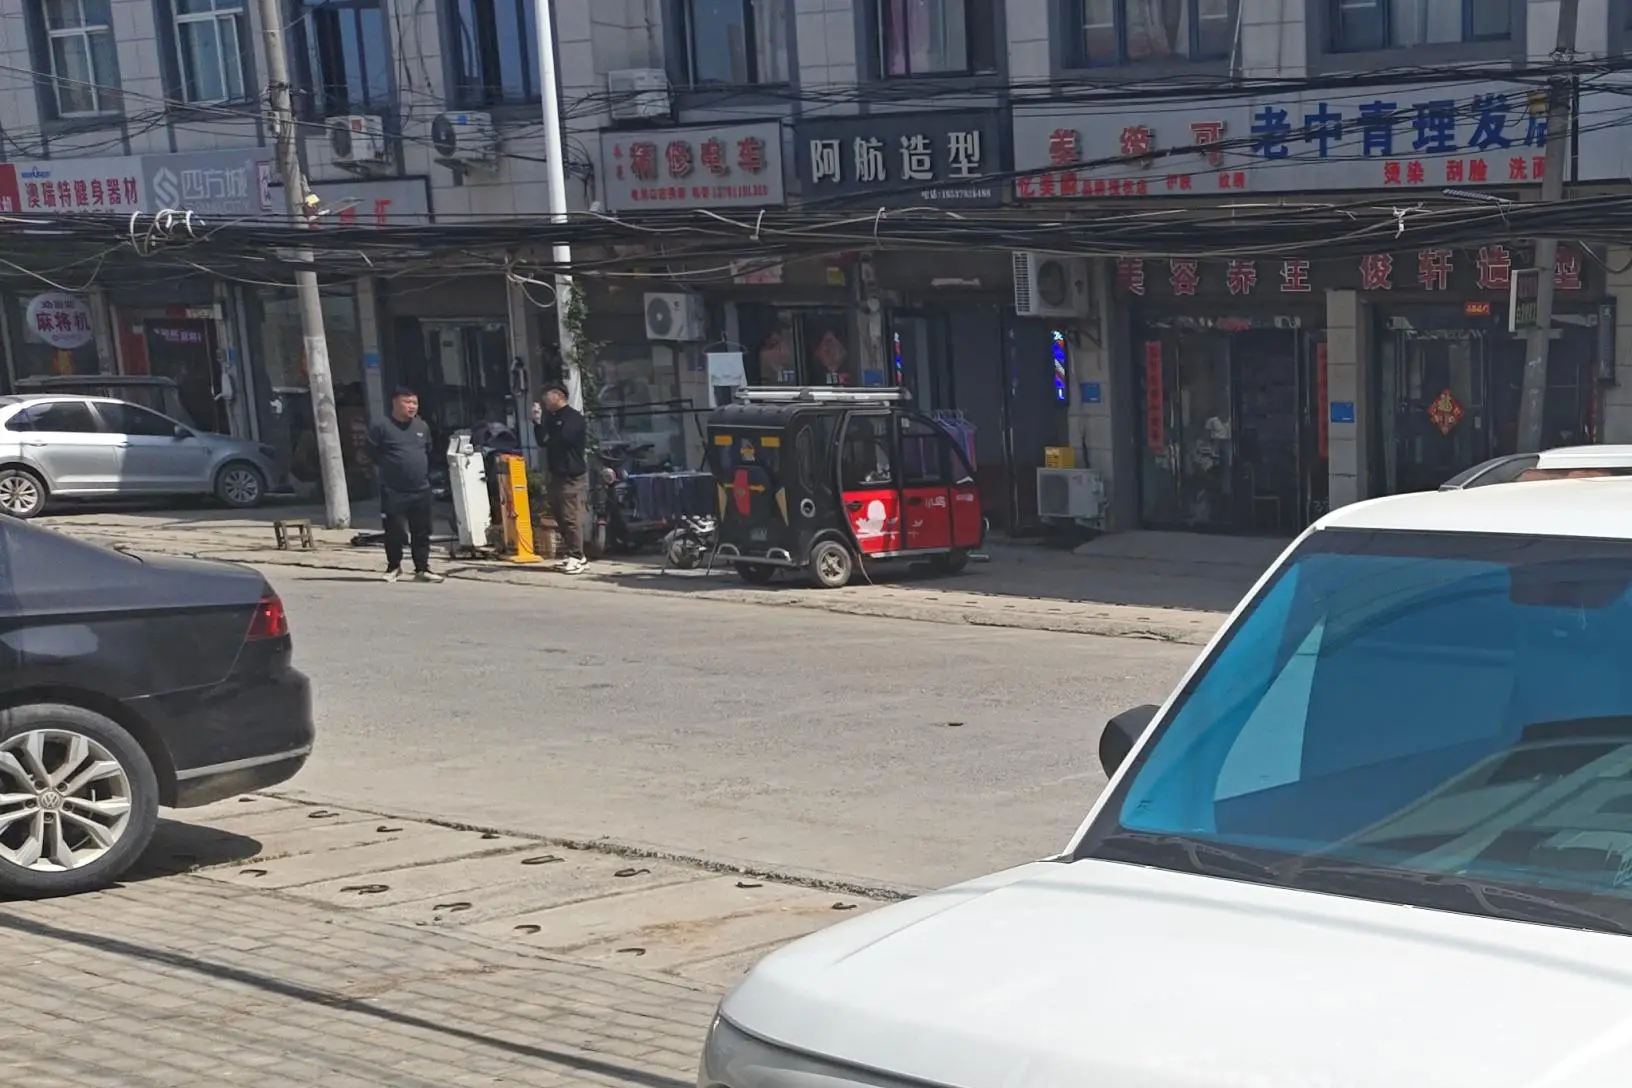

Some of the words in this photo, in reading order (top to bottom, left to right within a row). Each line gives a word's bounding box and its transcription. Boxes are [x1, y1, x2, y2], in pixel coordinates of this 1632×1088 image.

[809, 130, 982, 184] 阿航造型
[1383, 161, 1425, 185] 烫染
[1446, 158, 1489, 183] 刮脸
[25, 176, 138, 209] 澳瑞特健身器材
[180, 168, 248, 199] 四方城
[36, 311, 91, 332] 麻将机
